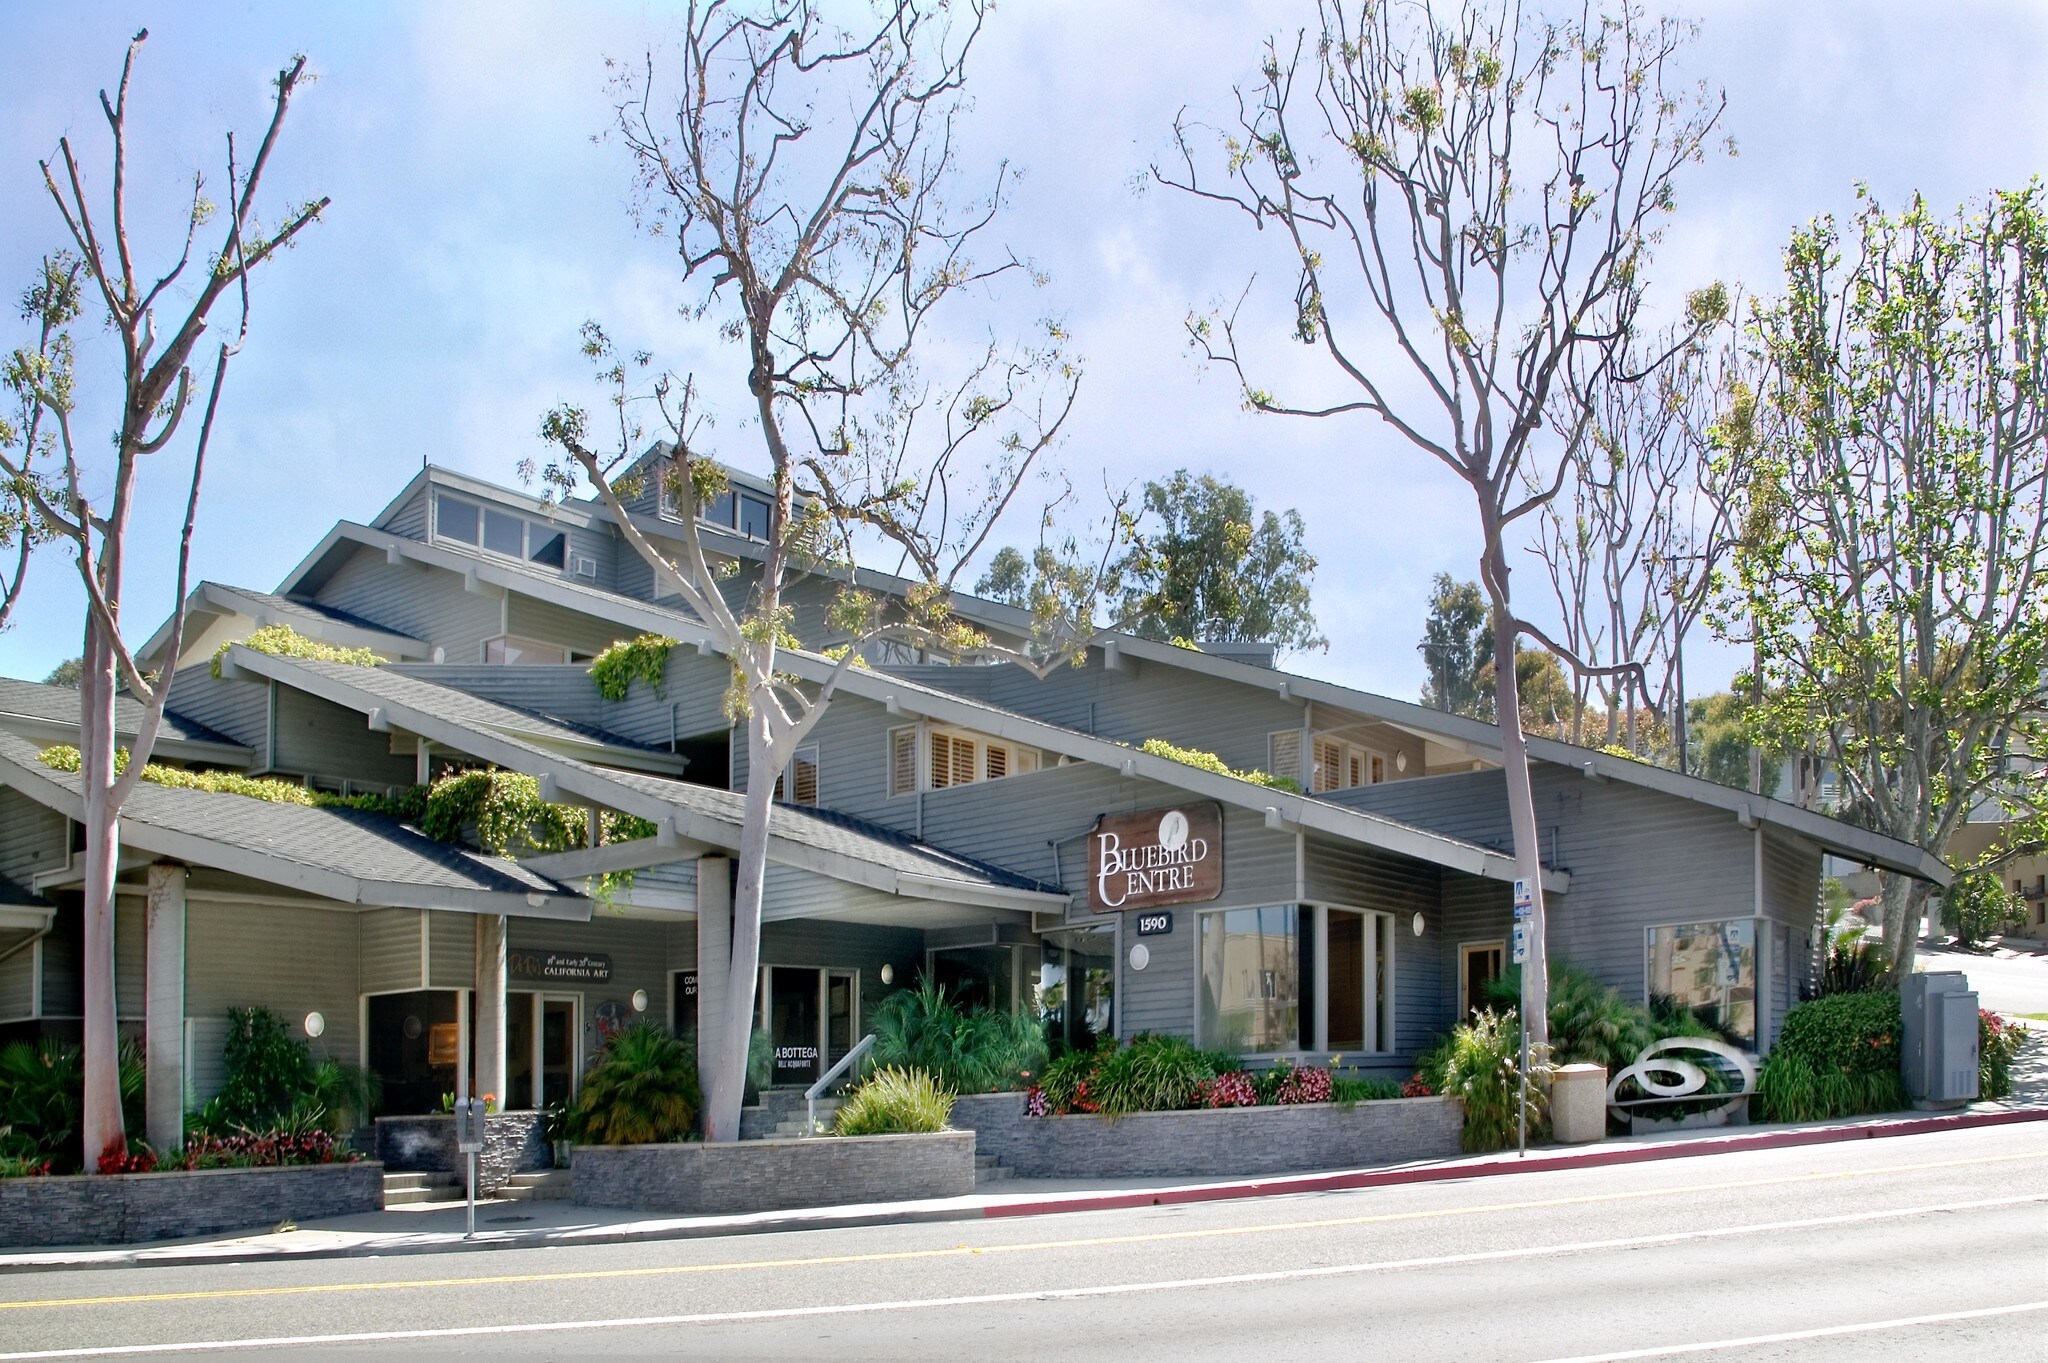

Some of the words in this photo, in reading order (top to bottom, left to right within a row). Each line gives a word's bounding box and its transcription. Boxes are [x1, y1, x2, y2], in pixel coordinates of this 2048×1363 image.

[1097, 832, 1208, 877] BLUEBIRD
[1099, 862, 1195, 907] CENTRE
[1140, 917, 1167, 932] 1590
[566, 959, 578, 968] Early
[588, 960, 606, 969] Century
[544, 966, 591, 977] CALIFORNIA
[593, 969, 609, 979] ART
[782, 1047, 818, 1058] BOTTEGA
